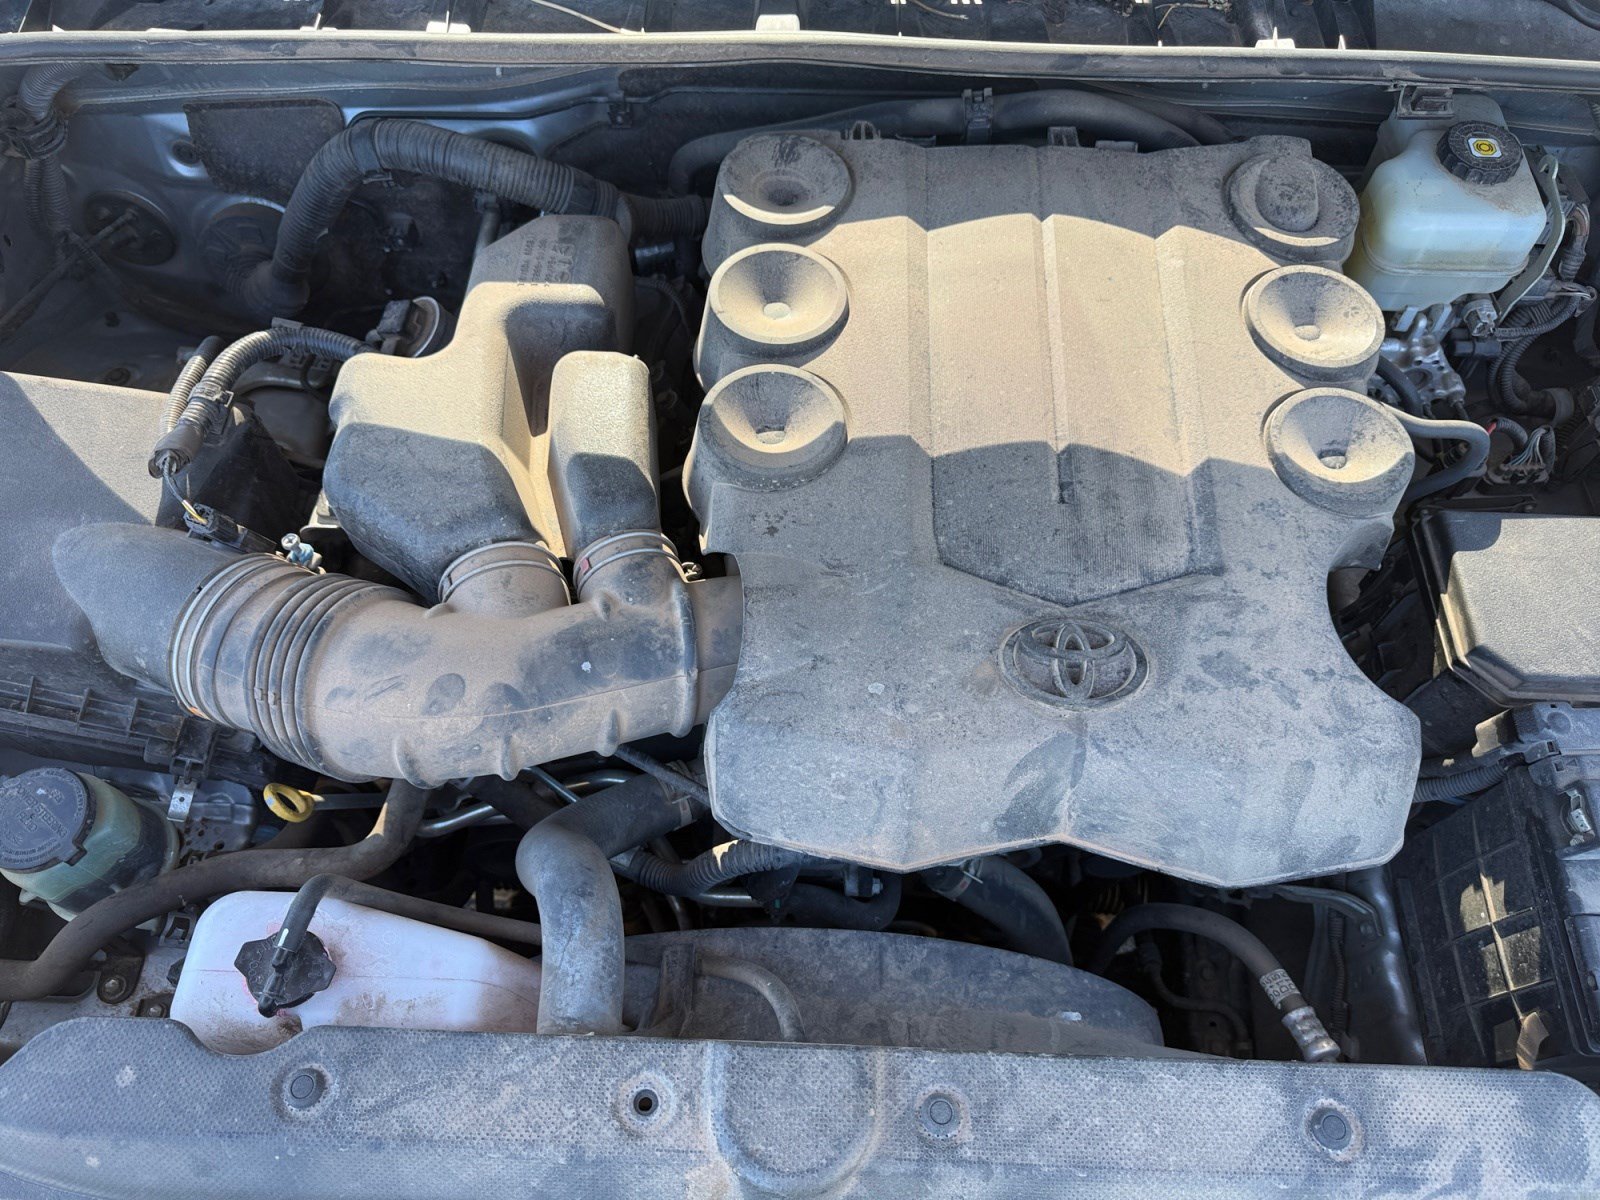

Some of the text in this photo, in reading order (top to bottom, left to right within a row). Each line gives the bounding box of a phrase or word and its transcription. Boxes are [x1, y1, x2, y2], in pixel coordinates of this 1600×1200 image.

[15, 783, 38, 807] POWER
[34, 803, 68, 838] STEERING
[16, 811, 38, 833] FLUID
